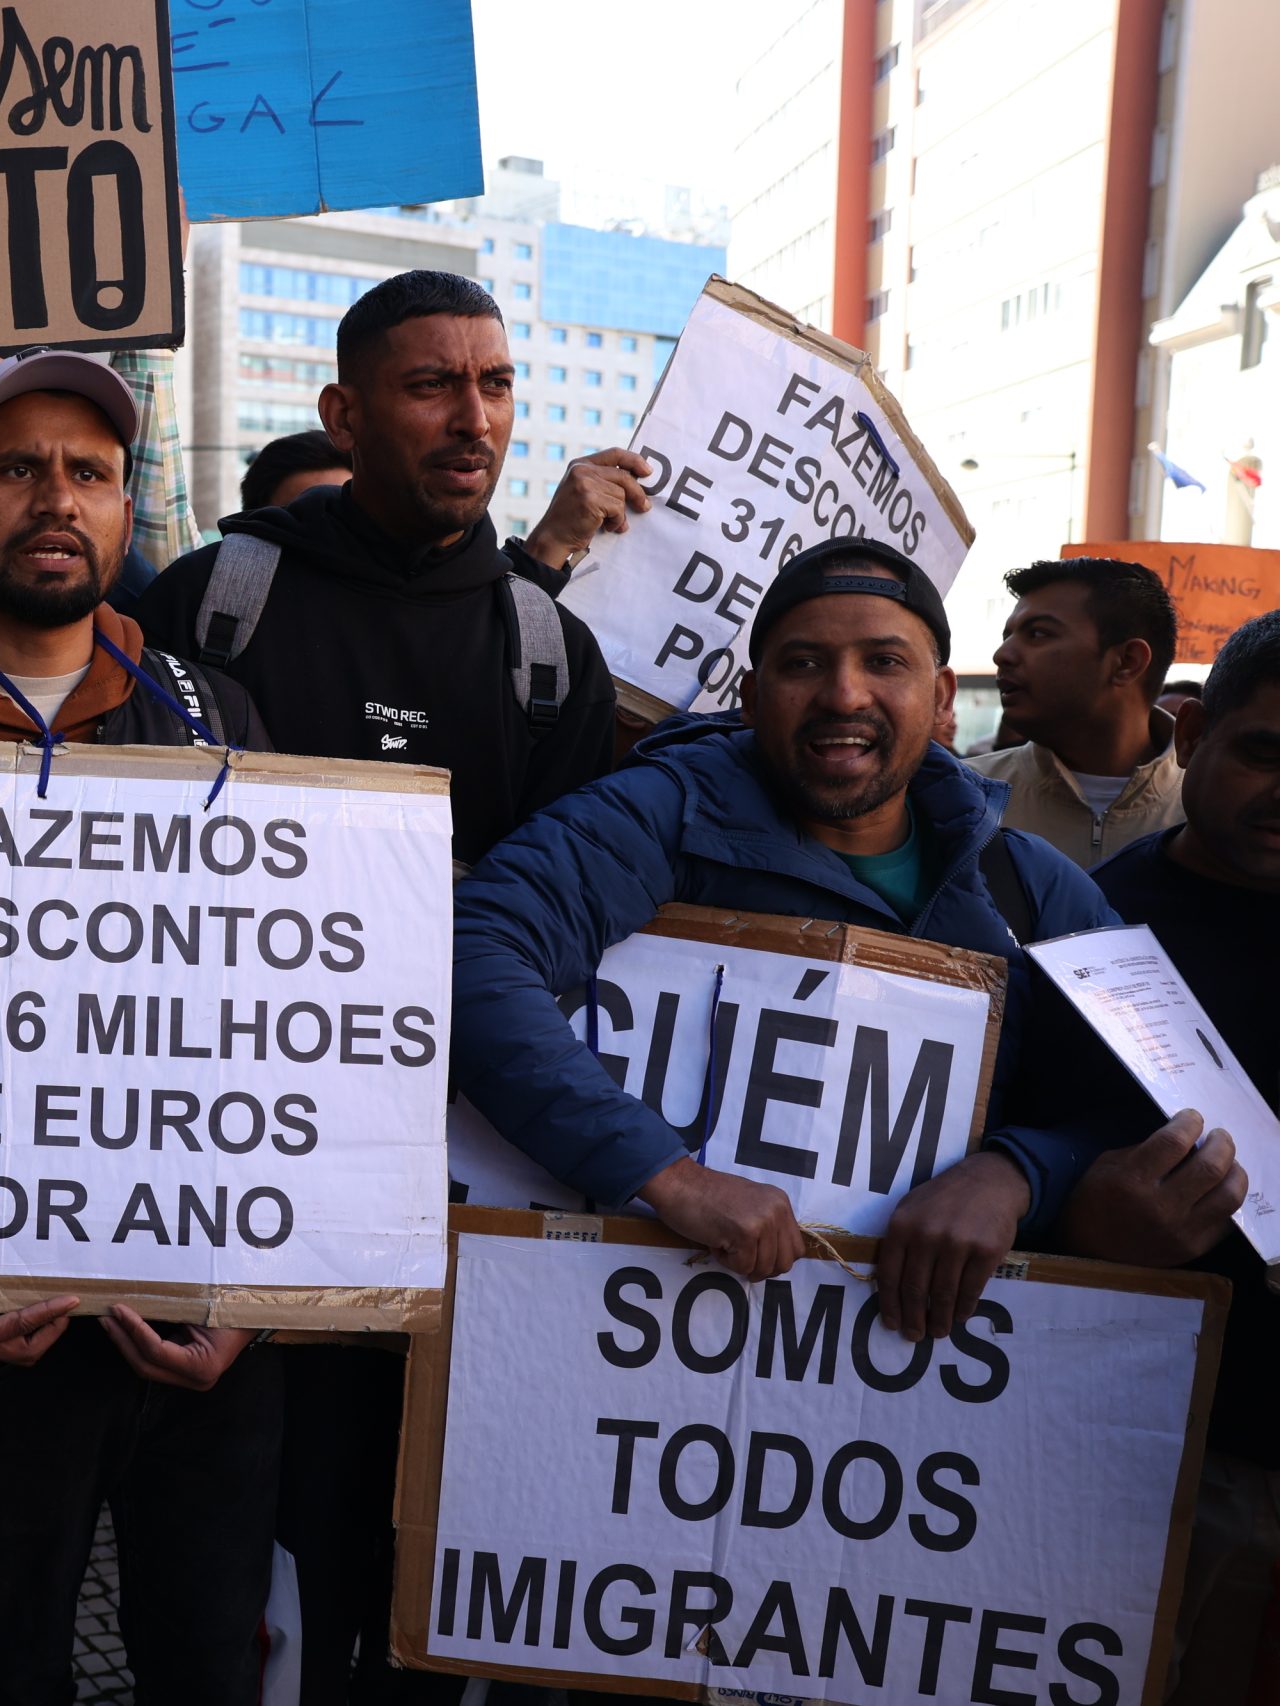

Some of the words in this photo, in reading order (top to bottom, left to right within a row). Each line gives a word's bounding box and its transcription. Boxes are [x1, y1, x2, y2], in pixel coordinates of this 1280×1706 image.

[637, 445, 713, 521] DE
[721, 498, 803, 572] 316
[707, 411, 873, 542] DESCO
[777, 373, 926, 555] FAZEMOS
[672, 550, 763, 625] DE
[365, 702, 398, 720] STWD
[400, 710, 429, 723] REC.
[76, 993, 436, 1068] MILHOES
[33, 1085, 319, 1156] EUROS
[111, 1183, 295, 1250] ANO
[597, 1266, 1015, 1404] SOMOS
[596, 1417, 982, 1553] TODOS
[436, 1548, 1124, 1706] IMIGRANTES
